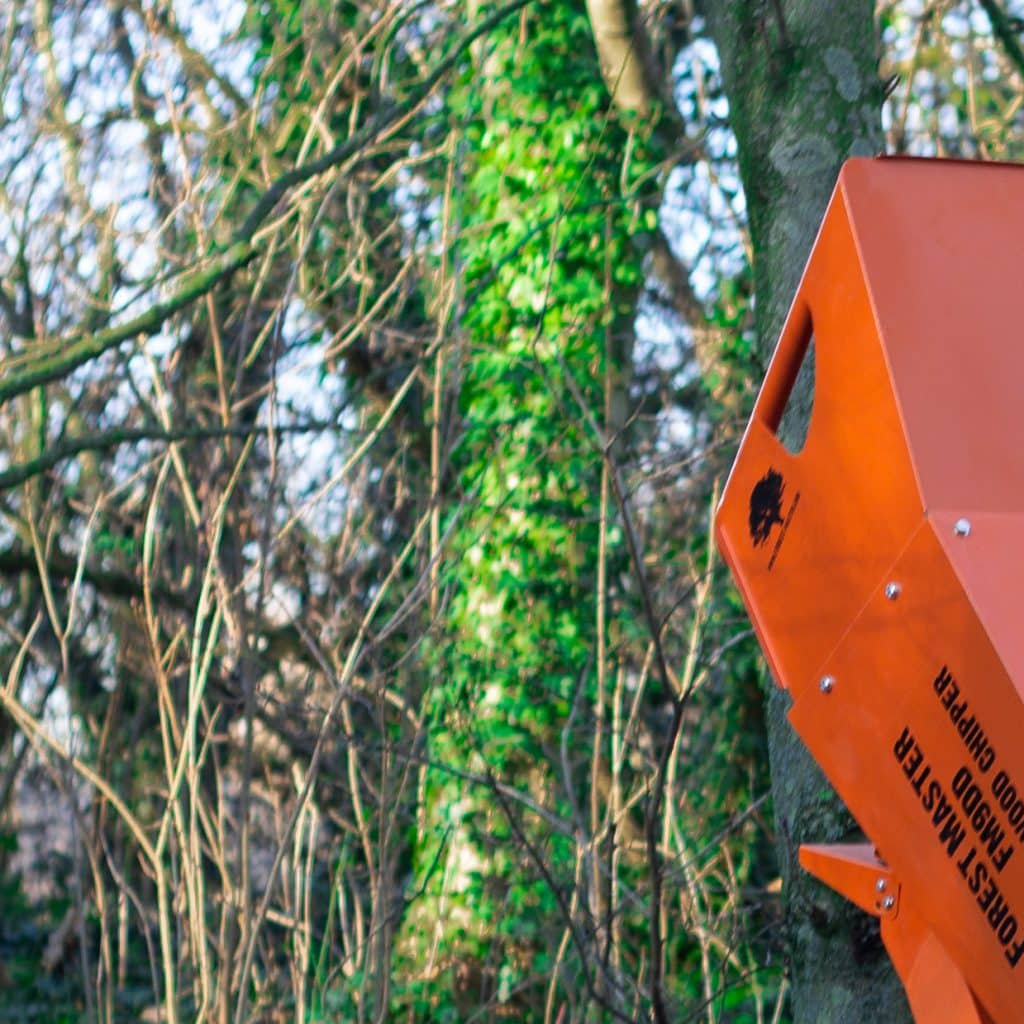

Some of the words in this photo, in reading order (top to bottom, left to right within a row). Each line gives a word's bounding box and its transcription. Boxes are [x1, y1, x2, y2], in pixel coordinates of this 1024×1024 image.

[933, 665, 996, 774] CHIPPER
[893, 727, 967, 858] MASTER
[951, 765, 1015, 874] FM9DD
